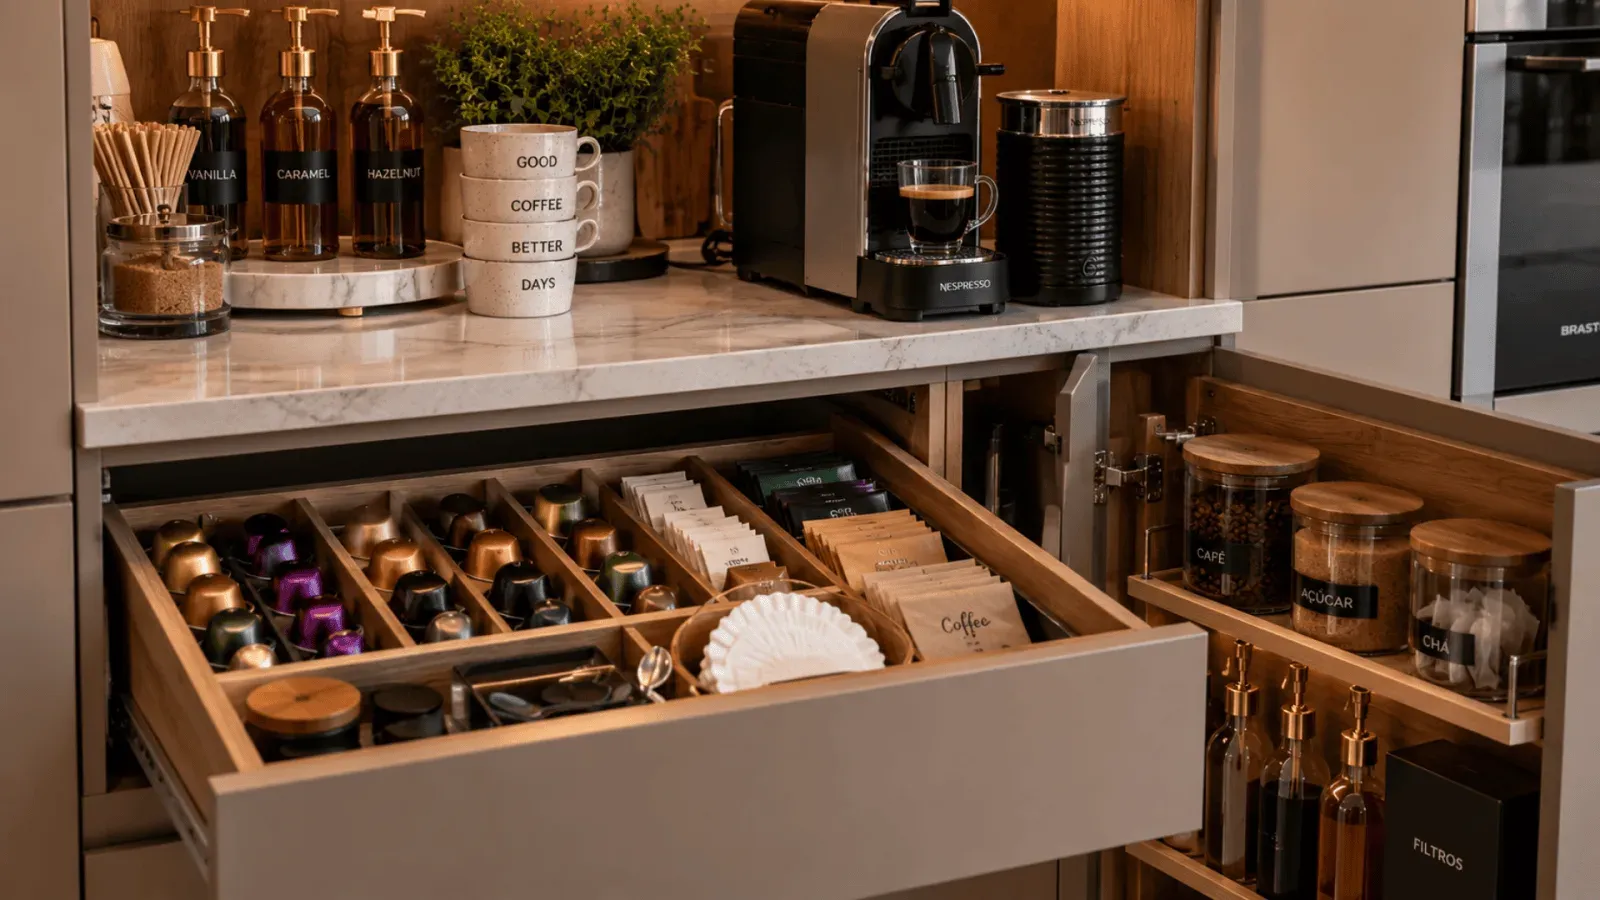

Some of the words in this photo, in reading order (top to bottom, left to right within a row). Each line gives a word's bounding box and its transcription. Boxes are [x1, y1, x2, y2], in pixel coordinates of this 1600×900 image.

[516, 155, 558, 169] GOOD
[188, 169, 237, 180] VANILLA
[277, 168, 330, 180] CARAMEL
[367, 167, 421, 180] HAZELNUT
[510, 198, 563, 213] COFFEE
[511, 239, 563, 254] BETTER
[521, 277, 556, 291] DAYS
[939, 279, 991, 292] NESPRESSO
[1560, 321, 1600, 336] BRAST
[1197, 547, 1226, 565] CAFÉ
[1301, 587, 1353, 609] AÇÚCAR
[941, 610, 991, 638] Coffee
[1422, 633, 1451, 655] CHÁ
[1413, 837, 1463, 871] FILTROS
